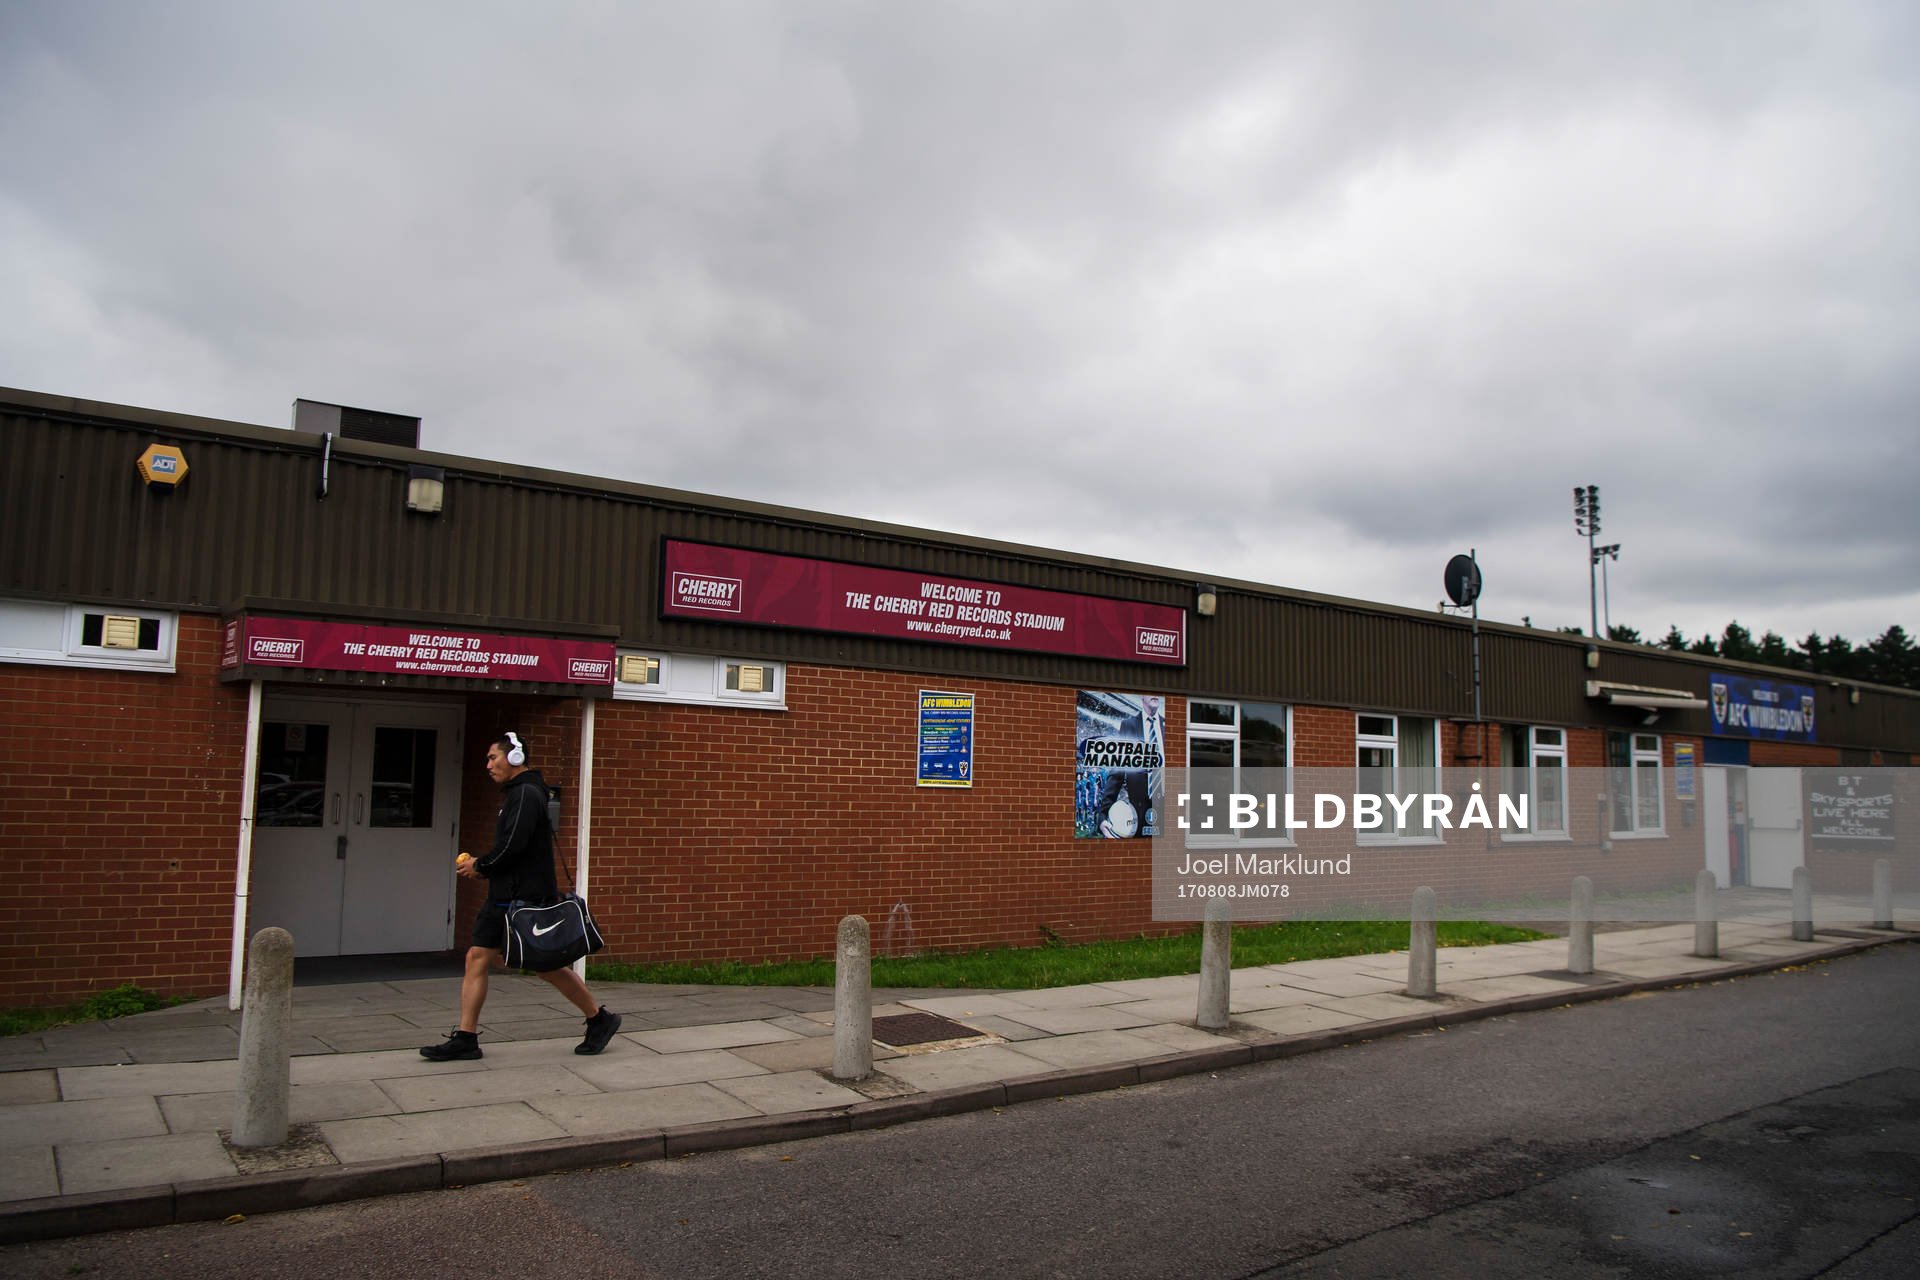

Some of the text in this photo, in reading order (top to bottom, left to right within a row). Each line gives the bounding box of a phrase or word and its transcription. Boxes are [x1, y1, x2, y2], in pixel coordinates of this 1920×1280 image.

[151, 459, 177, 470] ADT
[678, 578, 737, 599] CHERRY
[921, 582, 1001, 606] WELCOME TO
[699, 597, 732, 607] RECORDS
[845, 592, 1065, 631] THE CHERRY RED RECORDS STADIUM
[906, 620, 1012, 641] www.cherryred.co.uk
[409, 634, 481, 650] WELCOME TO
[1139, 631, 1176, 647] CHERRY
[254, 640, 300, 653] CHERRY
[343, 642, 539, 666] THE CHERRY RED RECORDS STADIUM
[396, 660, 489, 674] www.cherryred.co.uk
[572, 661, 609, 673] CHERRY
[922, 698, 972, 708] AFC WIMBLEDON
[1728, 703, 1803, 732] AFC WIMBLEDON
[1086, 740, 1158, 756] FOOTBALL
[1084, 754, 1160, 768] MANAGER
[1811, 792, 1893, 807] SKY SPORTS
[1813, 808, 1890, 818] LIVE HERE
[1840, 819, 1864, 827] ALL
[1823, 826, 1881, 836] WELCOME
